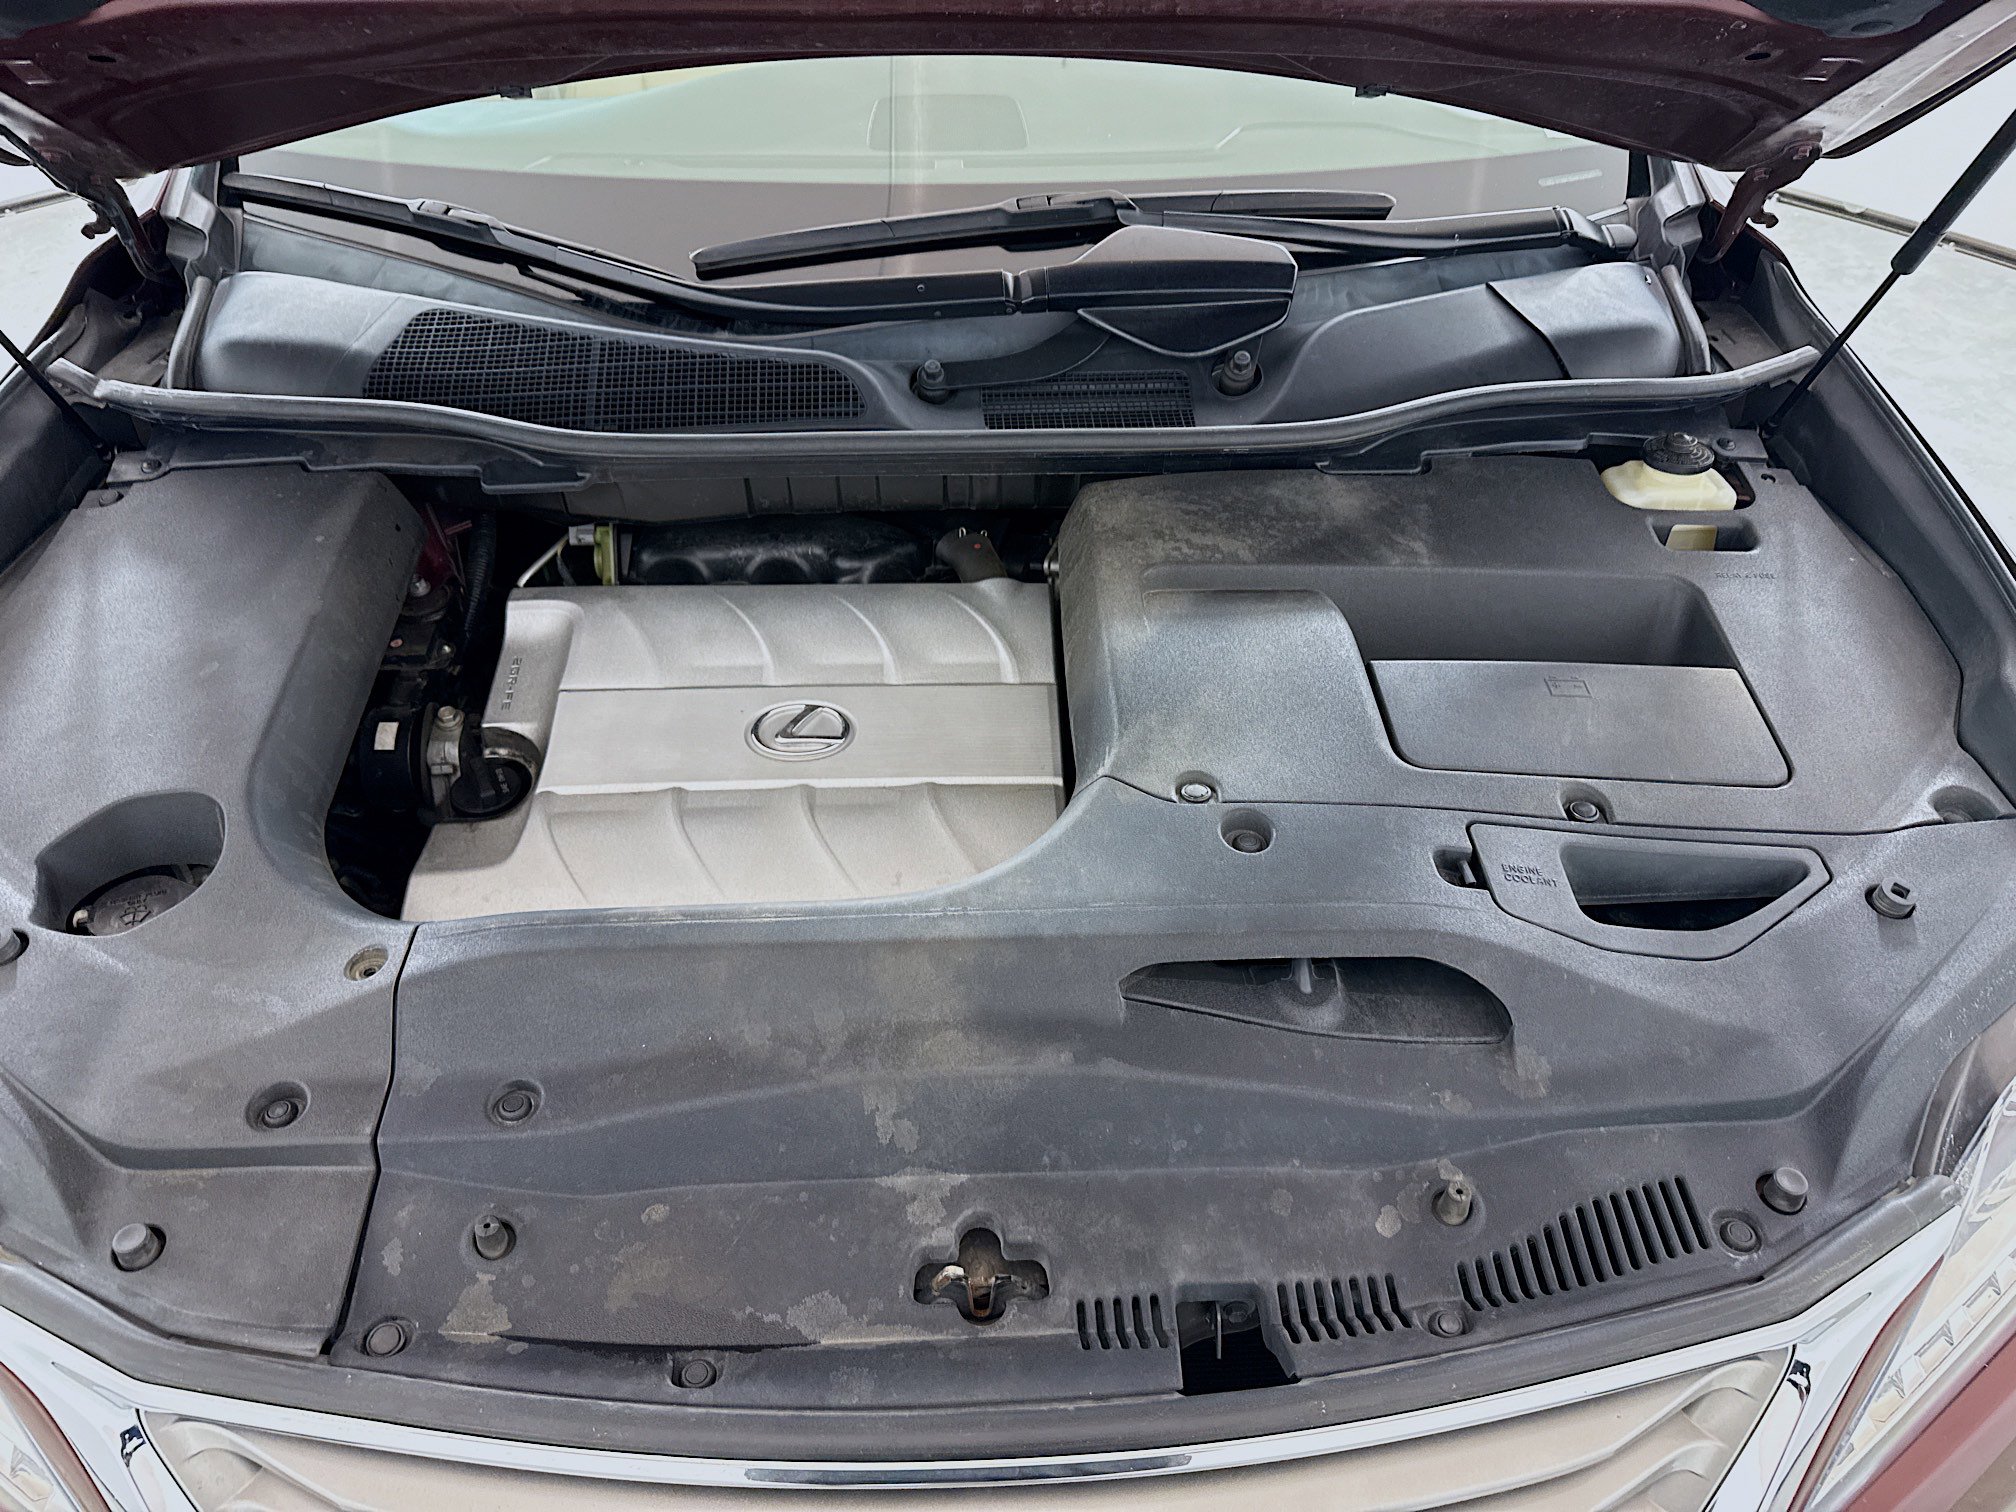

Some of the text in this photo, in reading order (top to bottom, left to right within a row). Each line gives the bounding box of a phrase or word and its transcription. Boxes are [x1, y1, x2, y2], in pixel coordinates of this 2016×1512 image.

[501, 655, 522, 711] 2GR-FE
[1501, 863, 1543, 876] ENGINE
[1504, 873, 1558, 888] COOLANT
